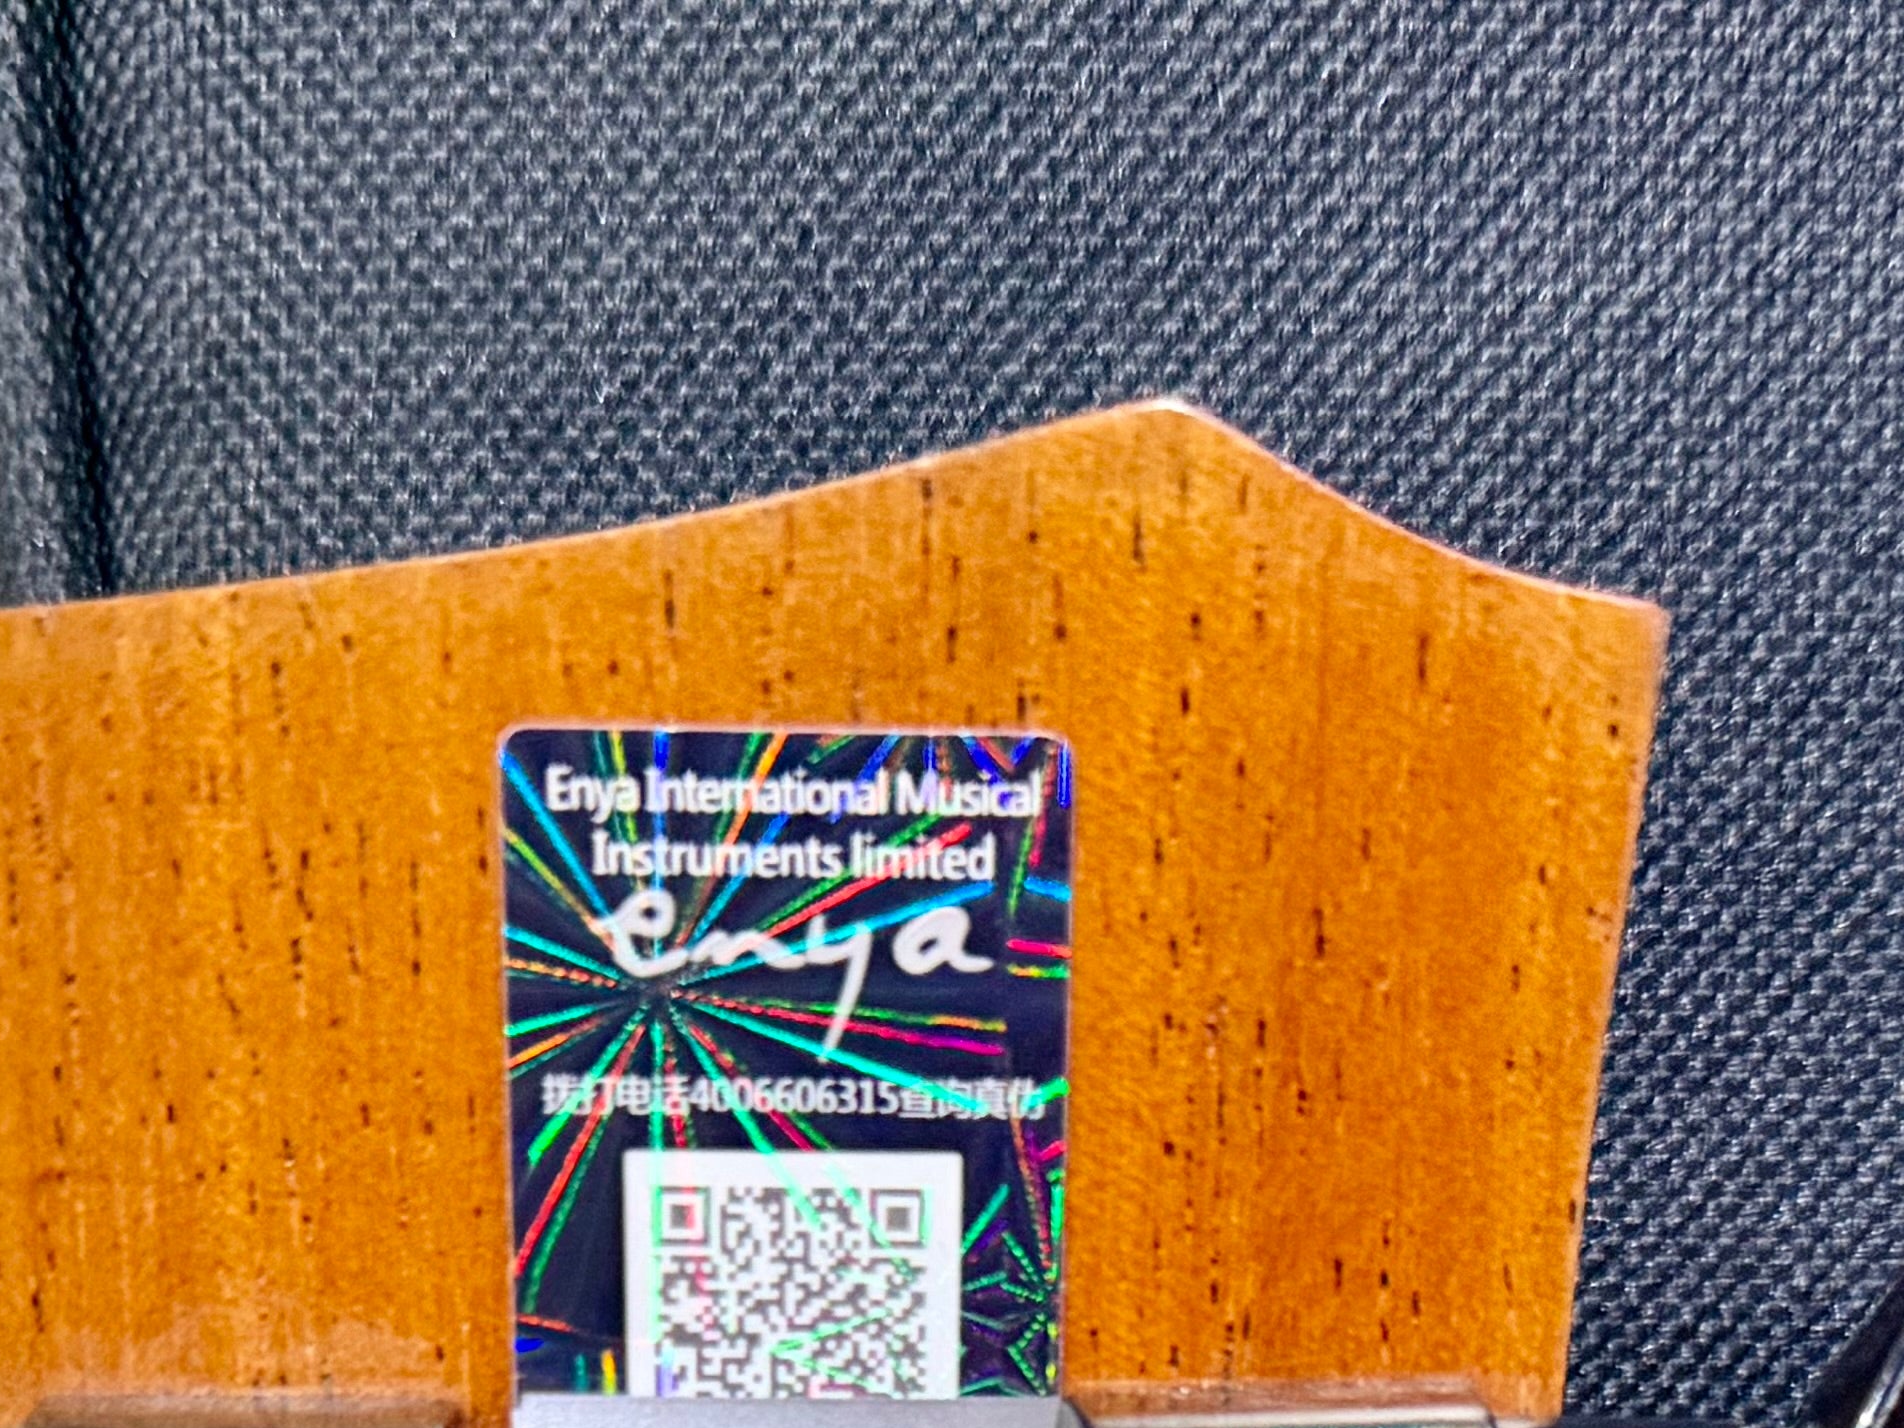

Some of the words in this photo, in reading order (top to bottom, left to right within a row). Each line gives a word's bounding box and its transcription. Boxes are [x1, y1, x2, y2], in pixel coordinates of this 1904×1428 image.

[545, 764, 641, 823] Enya
[647, 768, 889, 816] International
[896, 770, 1042, 817] Musical
[592, 835, 843, 880] Instruments
[851, 836, 995, 881] limited
[598, 888, 993, 1064] enya
